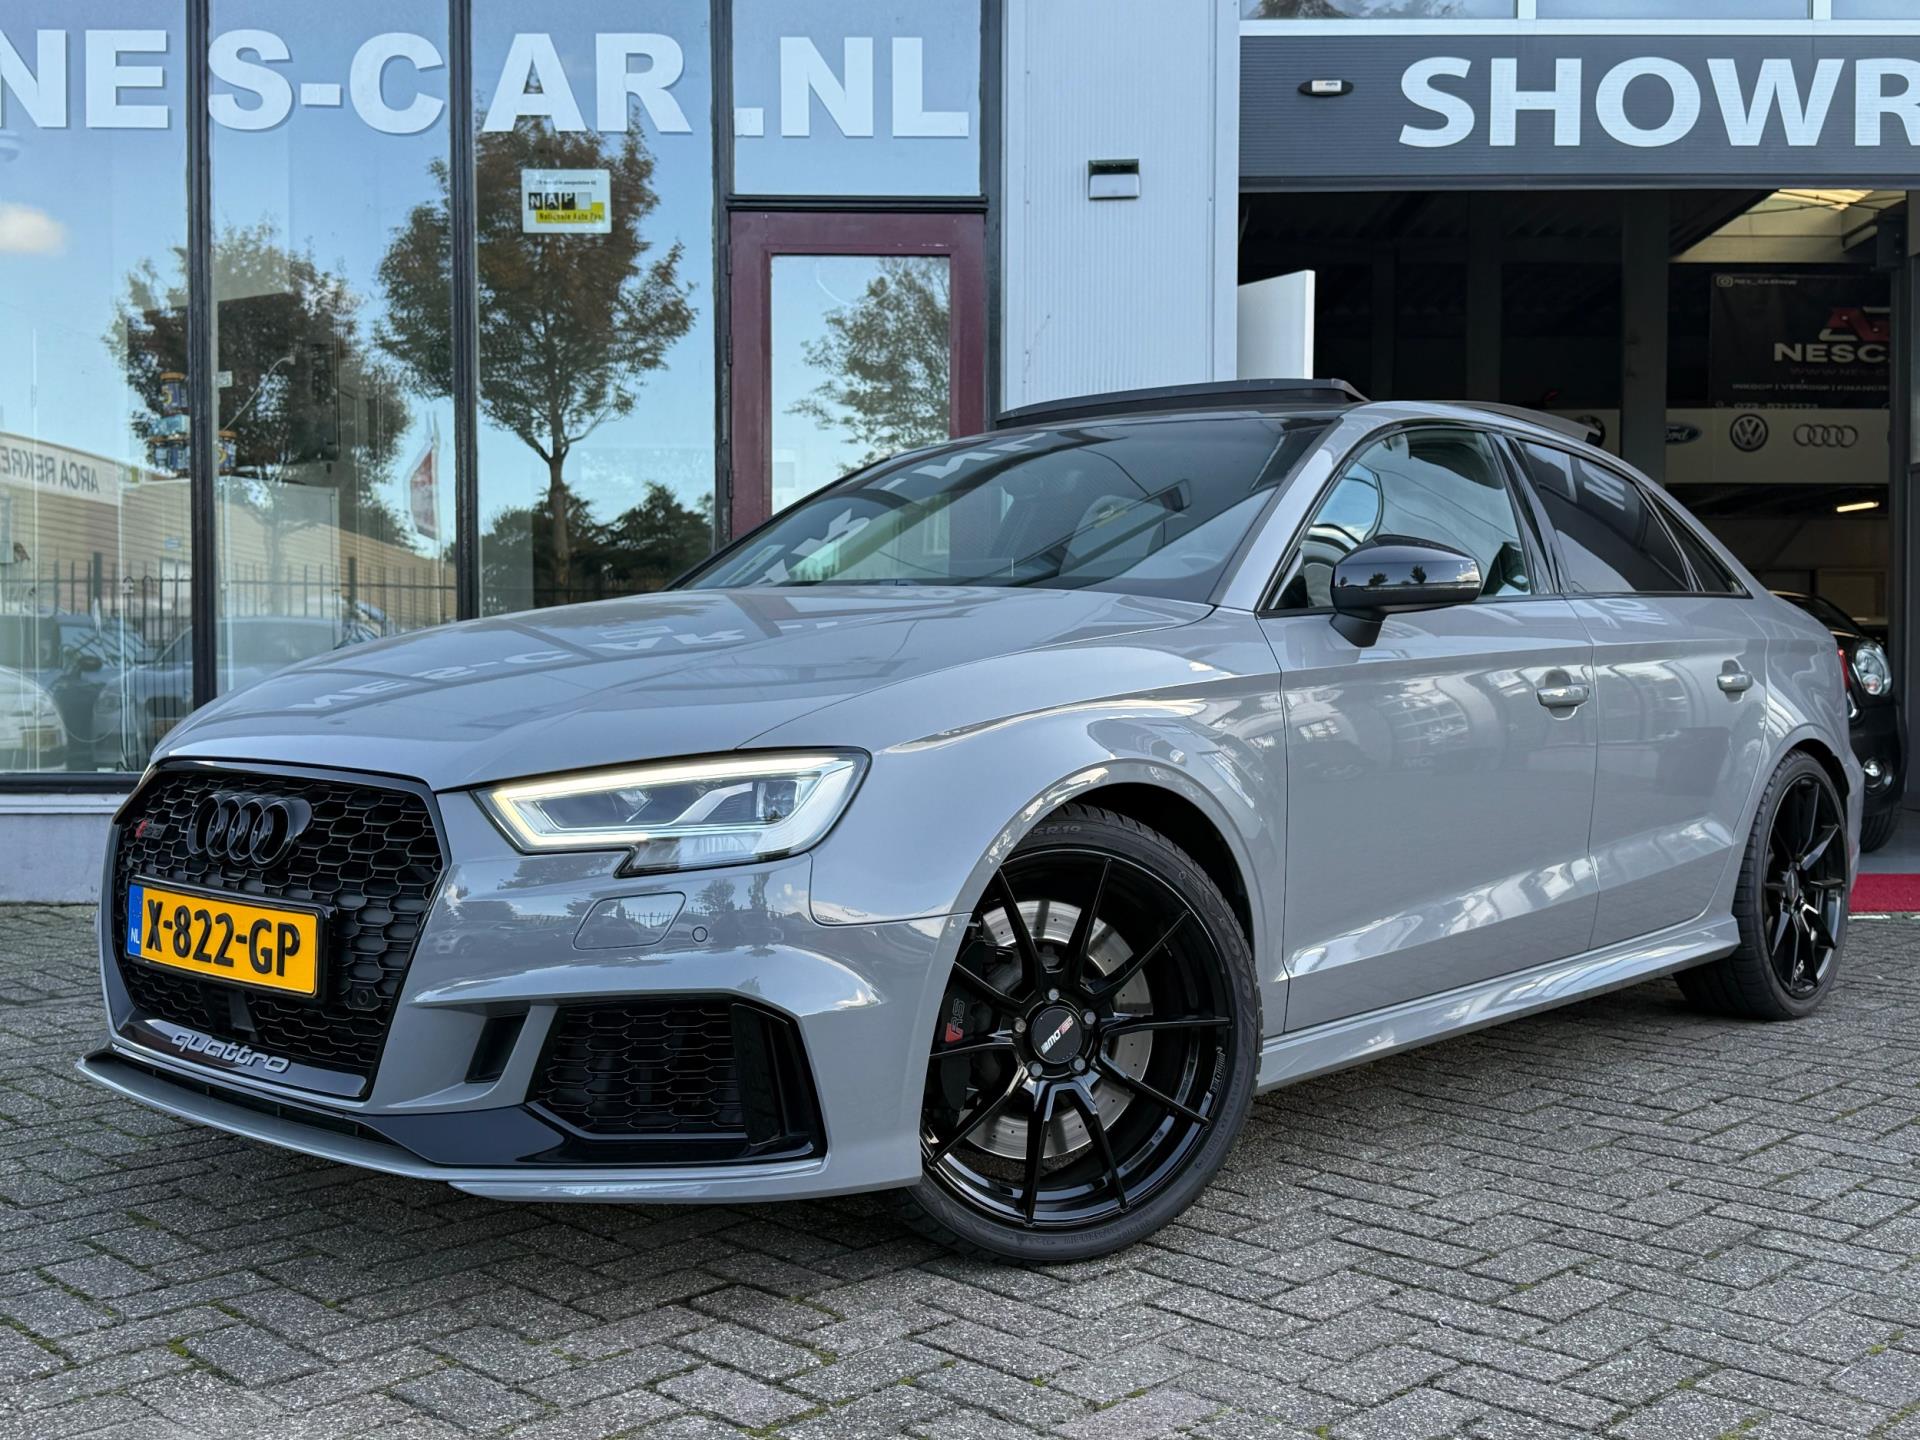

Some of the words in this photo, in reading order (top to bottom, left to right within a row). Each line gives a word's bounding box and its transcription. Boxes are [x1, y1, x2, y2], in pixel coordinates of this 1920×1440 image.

[1399, 56, 1920, 147] SHOWR
[530, 192, 573, 208] NAP
[1774, 343, 1890, 363] NESC
[130, 927, 140, 944] NL
[146, 899, 301, 977] X-822-GP
[172, 1032, 290, 1073] quattro
